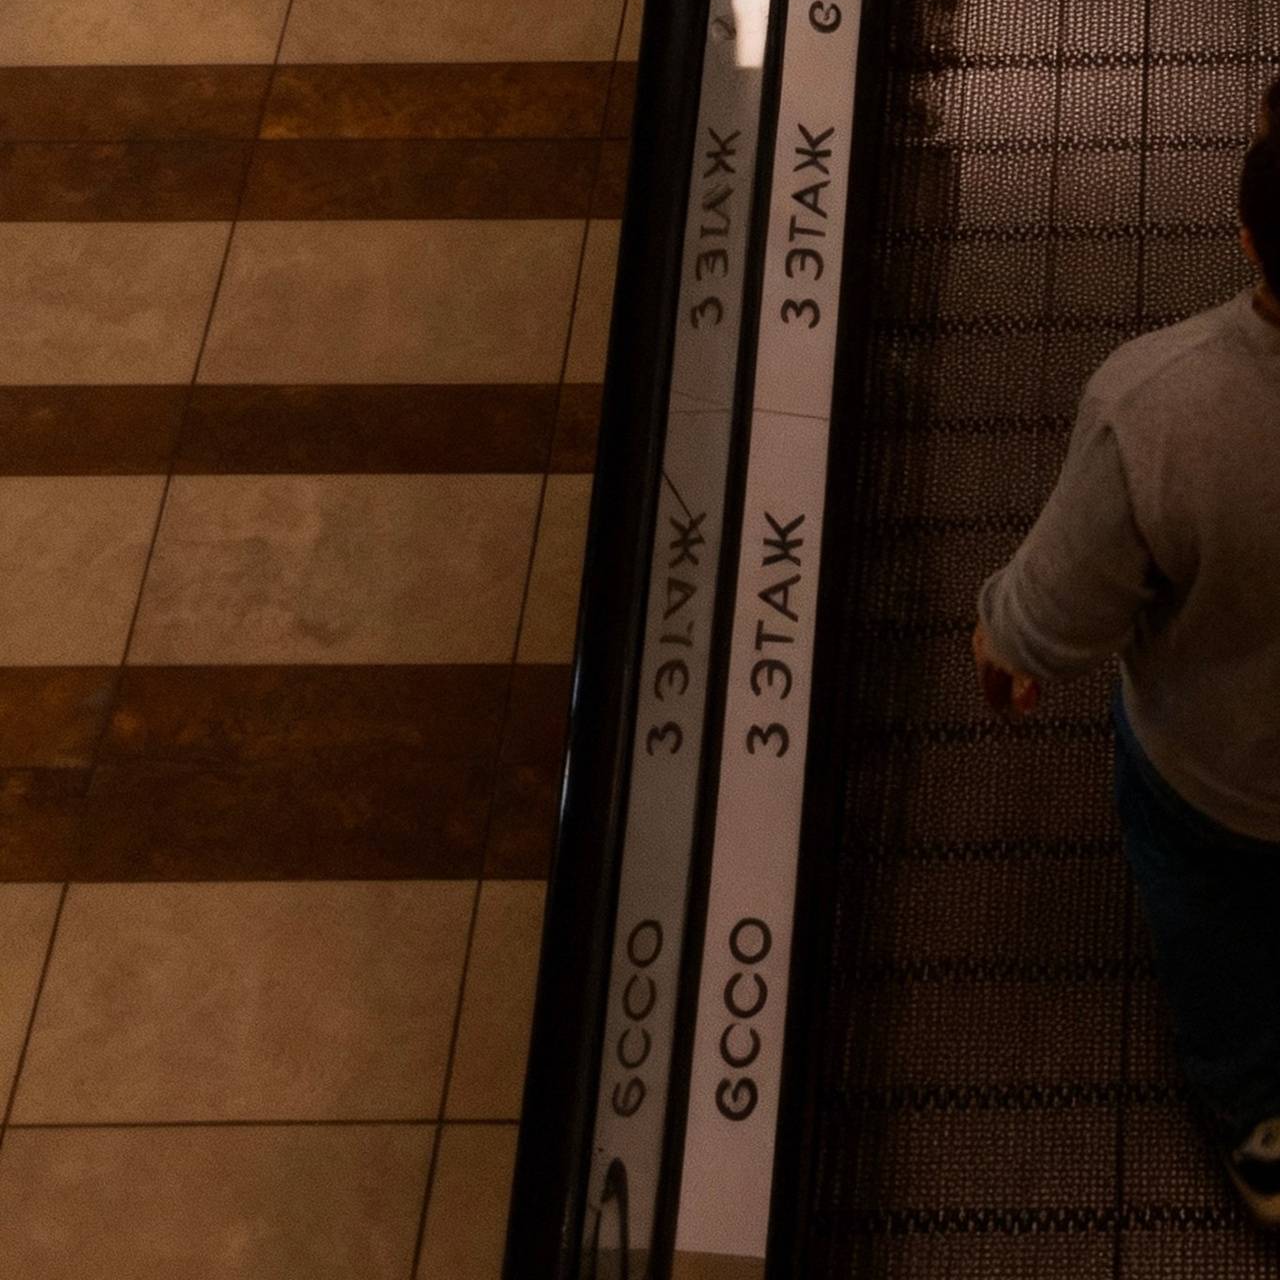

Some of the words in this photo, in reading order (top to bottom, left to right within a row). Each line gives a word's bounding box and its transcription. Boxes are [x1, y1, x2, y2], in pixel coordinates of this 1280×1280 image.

[784, 123, 835, 281] ЭТАЖ
[780, 298, 821, 329] 3
[749, 512, 805, 700] ЭТАЖ
[745, 722, 790, 758] 3
